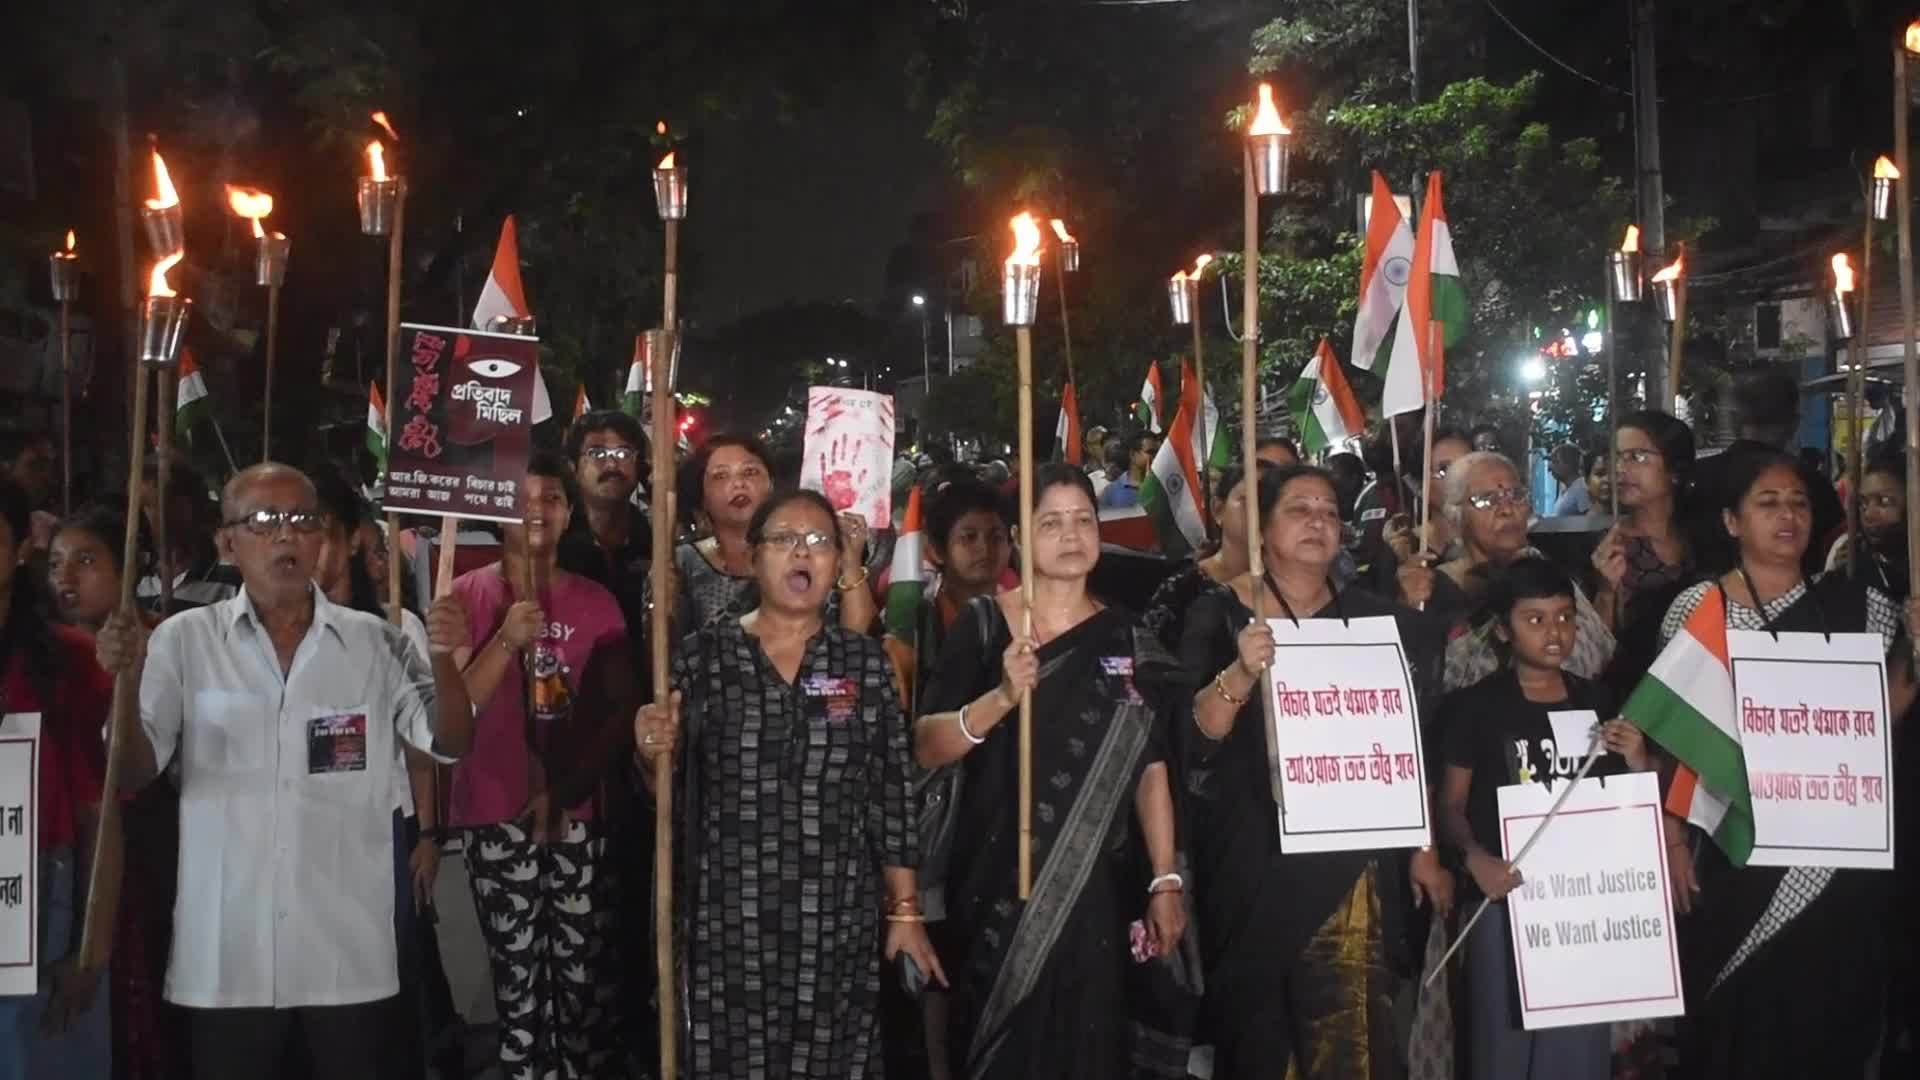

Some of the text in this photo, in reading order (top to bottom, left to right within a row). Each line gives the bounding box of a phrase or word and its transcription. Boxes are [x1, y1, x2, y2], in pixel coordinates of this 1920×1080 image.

[451, 380, 512, 404] প্রতিবাদ
[476, 401, 522, 424] মিছিল
[388, 486, 421, 498] আমরা
[427, 490, 451, 501] আজ
[466, 475, 495, 491] বিচার
[498, 480, 515, 494] চাই
[1277, 681, 1311, 720] বিচার
[1313, 685, 1343, 717] যতই
[1742, 697, 1775, 736] বিচার
[1779, 703, 1810, 735] যতই
[1285, 754, 1341, 788] আওয়াজ
[1343, 755, 1366, 782] তত
[1805, 774, 1831, 801] তত
[1521, 867, 1656, 900] We Want Justice
[1525, 914, 1662, 949] We Want Justice
